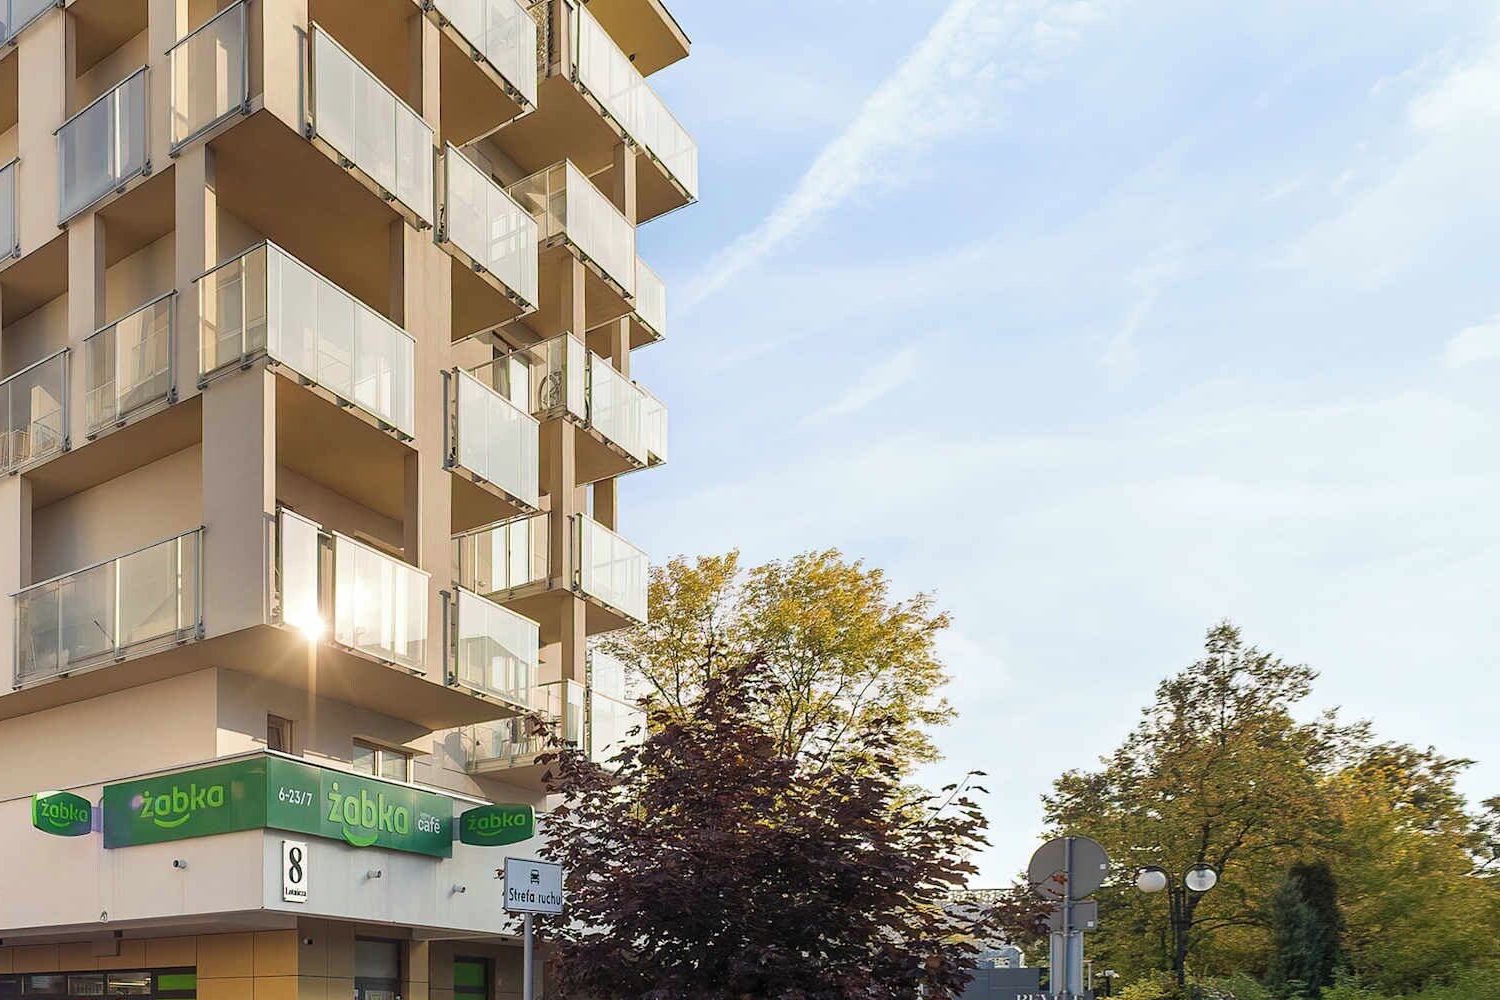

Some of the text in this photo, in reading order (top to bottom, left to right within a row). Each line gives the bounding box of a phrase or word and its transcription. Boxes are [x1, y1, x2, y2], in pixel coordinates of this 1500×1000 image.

[140, 784, 224, 817] żabka
[278, 787, 312, 806] 6-23/7
[41, 799, 88, 823] żabka
[328, 782, 409, 835] żabka
[417, 816, 441, 834] café
[467, 811, 526, 830] żabka
[288, 847, 303, 884] 8
[508, 887, 561, 906] Strefa ruchu
